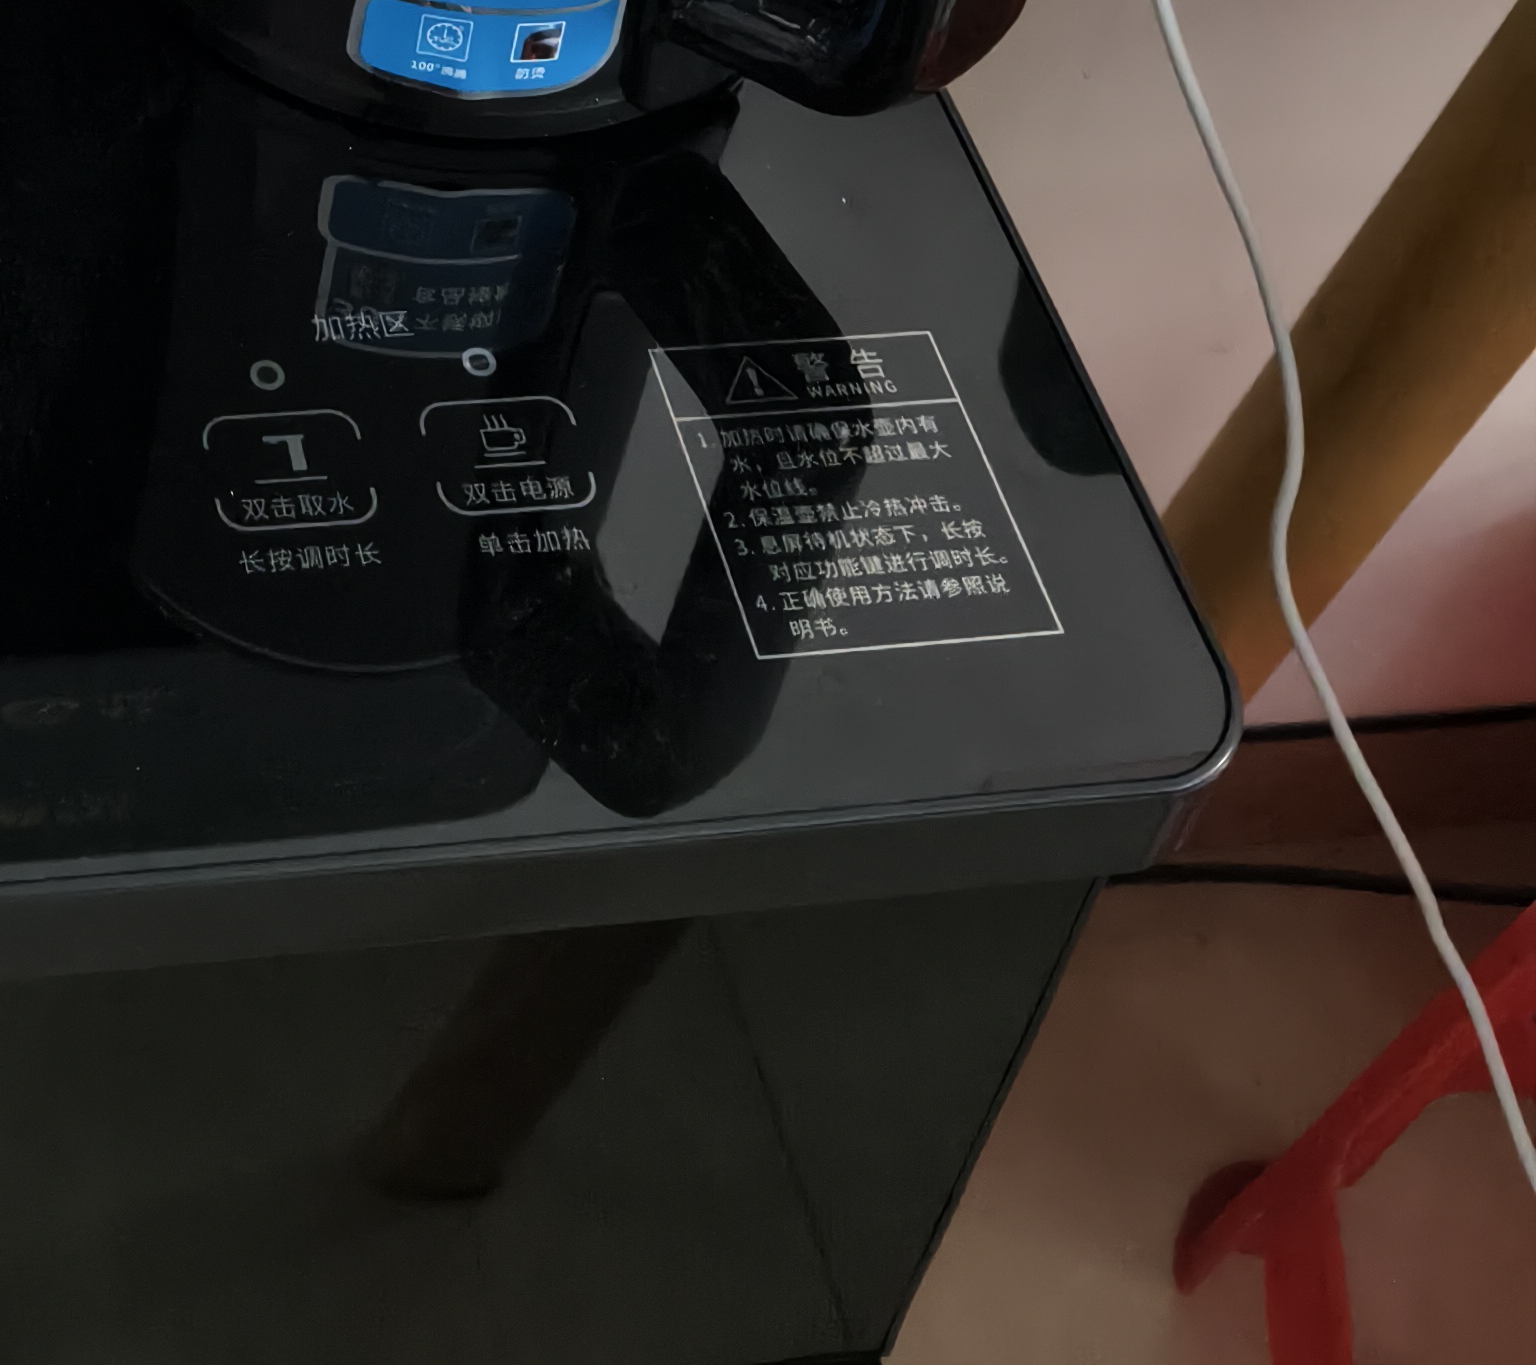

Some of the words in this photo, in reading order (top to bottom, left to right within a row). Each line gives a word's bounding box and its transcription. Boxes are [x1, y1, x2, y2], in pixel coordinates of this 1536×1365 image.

[805, 379, 898, 400] WARNING
[241, 491, 355, 522] 双击取水
[464, 476, 574, 506] 双击电源
[478, 526, 591, 557] 单击加热
[239, 542, 382, 575] 长按调时长
